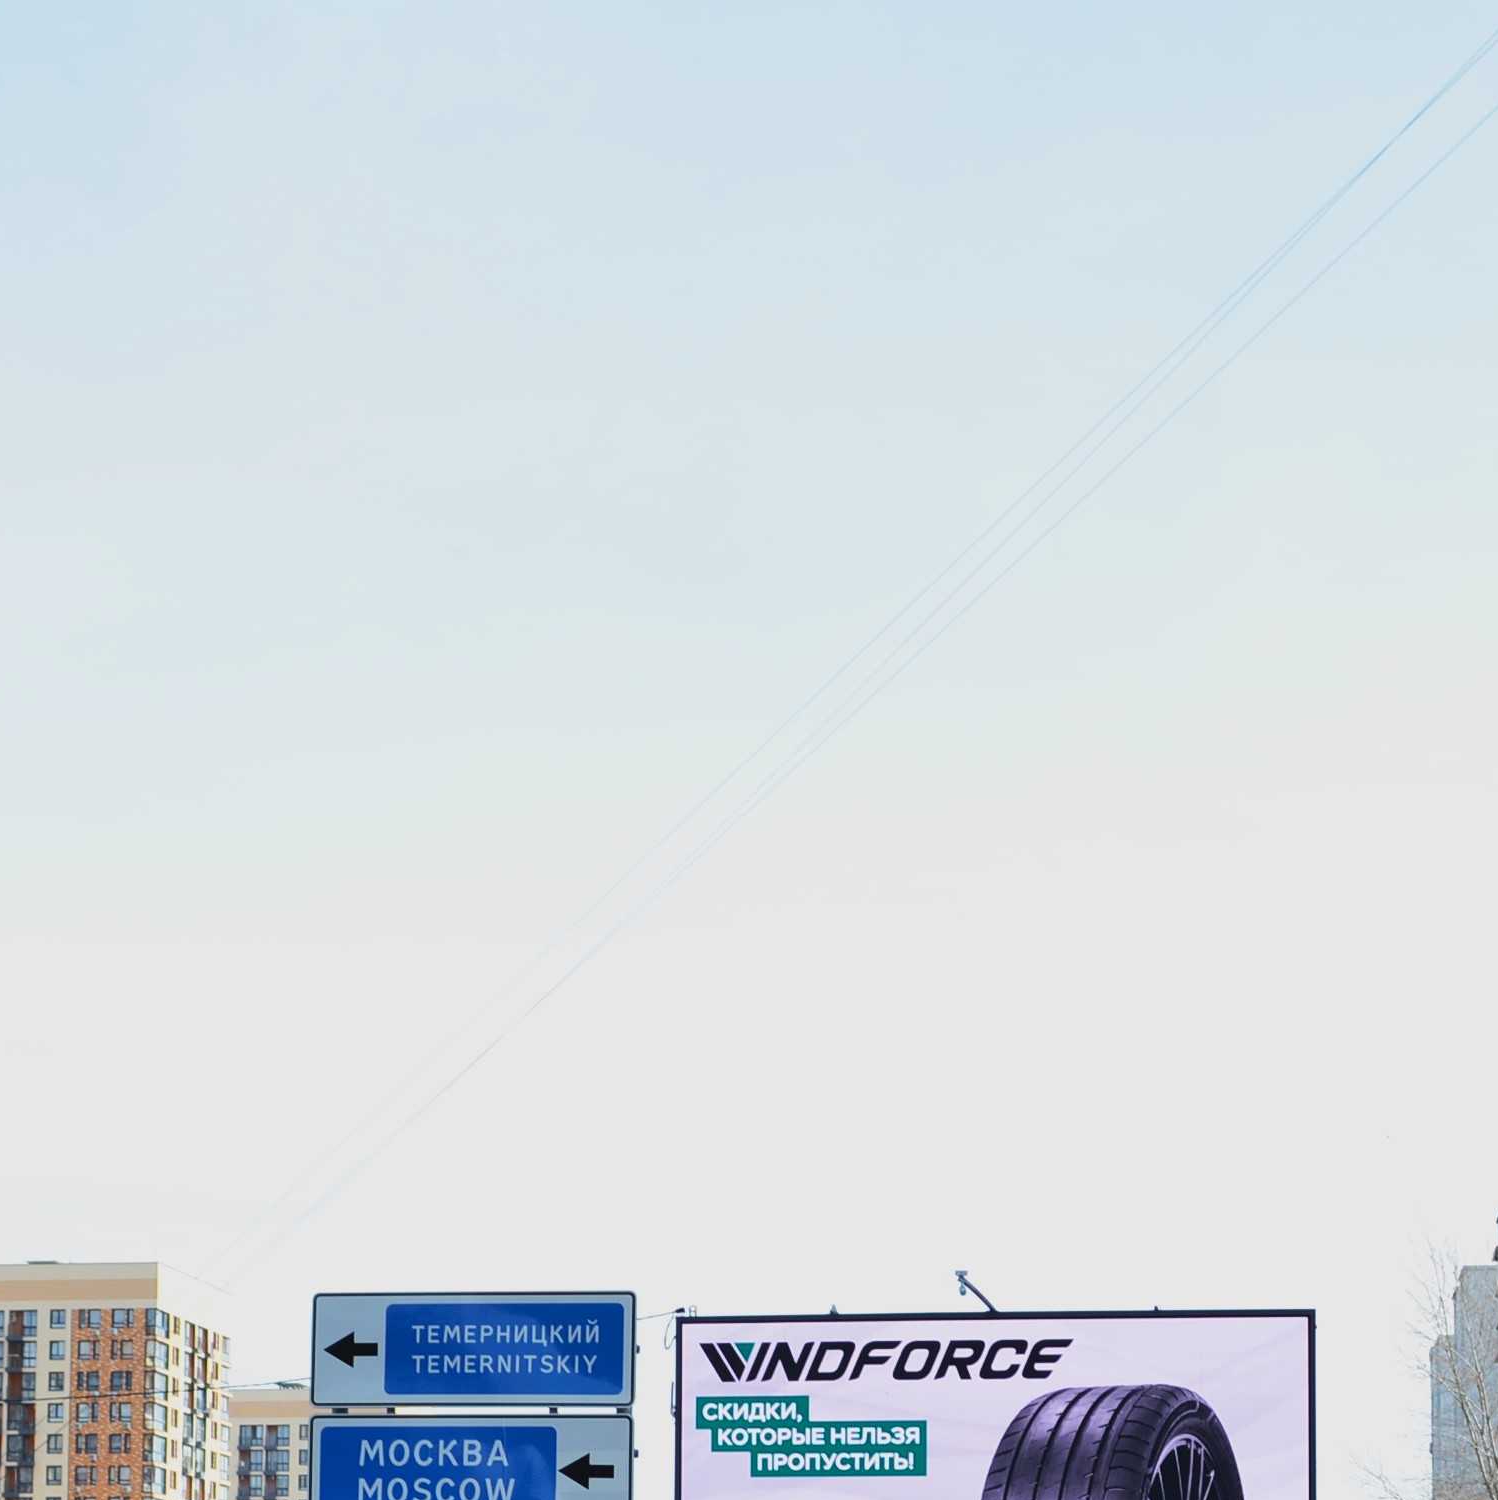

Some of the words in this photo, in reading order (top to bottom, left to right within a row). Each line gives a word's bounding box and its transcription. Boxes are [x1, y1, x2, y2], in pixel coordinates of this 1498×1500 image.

[412, 1319, 600, 1347] ТЕМЕРНИЦКИЙ
[412, 1355, 598, 1374] TEMERNITSKIY
[702, 1402, 803, 1422] СКИДКИ,
[717, 1427, 825, 1446] КОТОРЫЕ
[830, 1427, 920, 1445] НЕЛЬЗЯ
[358, 1439, 509, 1467] МОСКВА
[757, 1452, 914, 1471] ПРОПУСТИТЬ!
